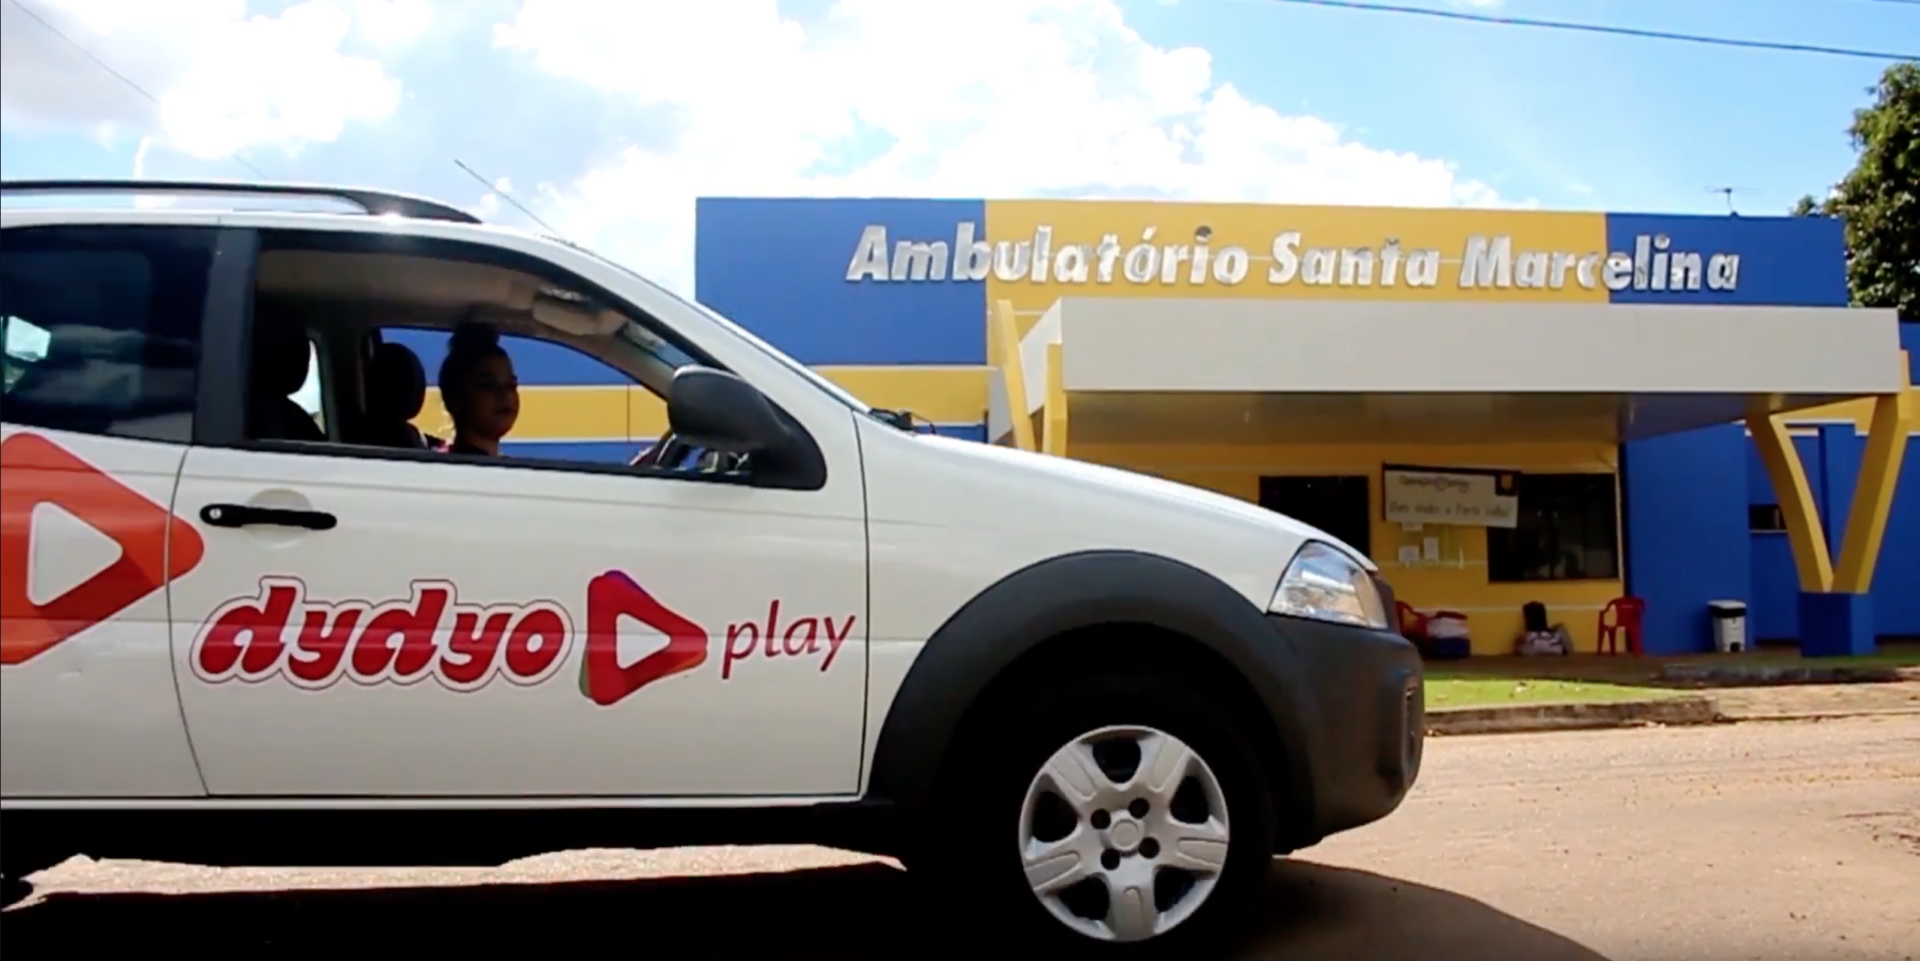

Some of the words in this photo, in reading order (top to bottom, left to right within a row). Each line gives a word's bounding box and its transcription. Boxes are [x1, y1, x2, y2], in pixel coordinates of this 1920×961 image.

[846, 222, 1248, 285] Ambulatório
[1267, 231, 1441, 285] Santa
[1458, 236, 1740, 290] Marcelina
[199, 585, 566, 683] dydyo
[722, 599, 856, 679] play
